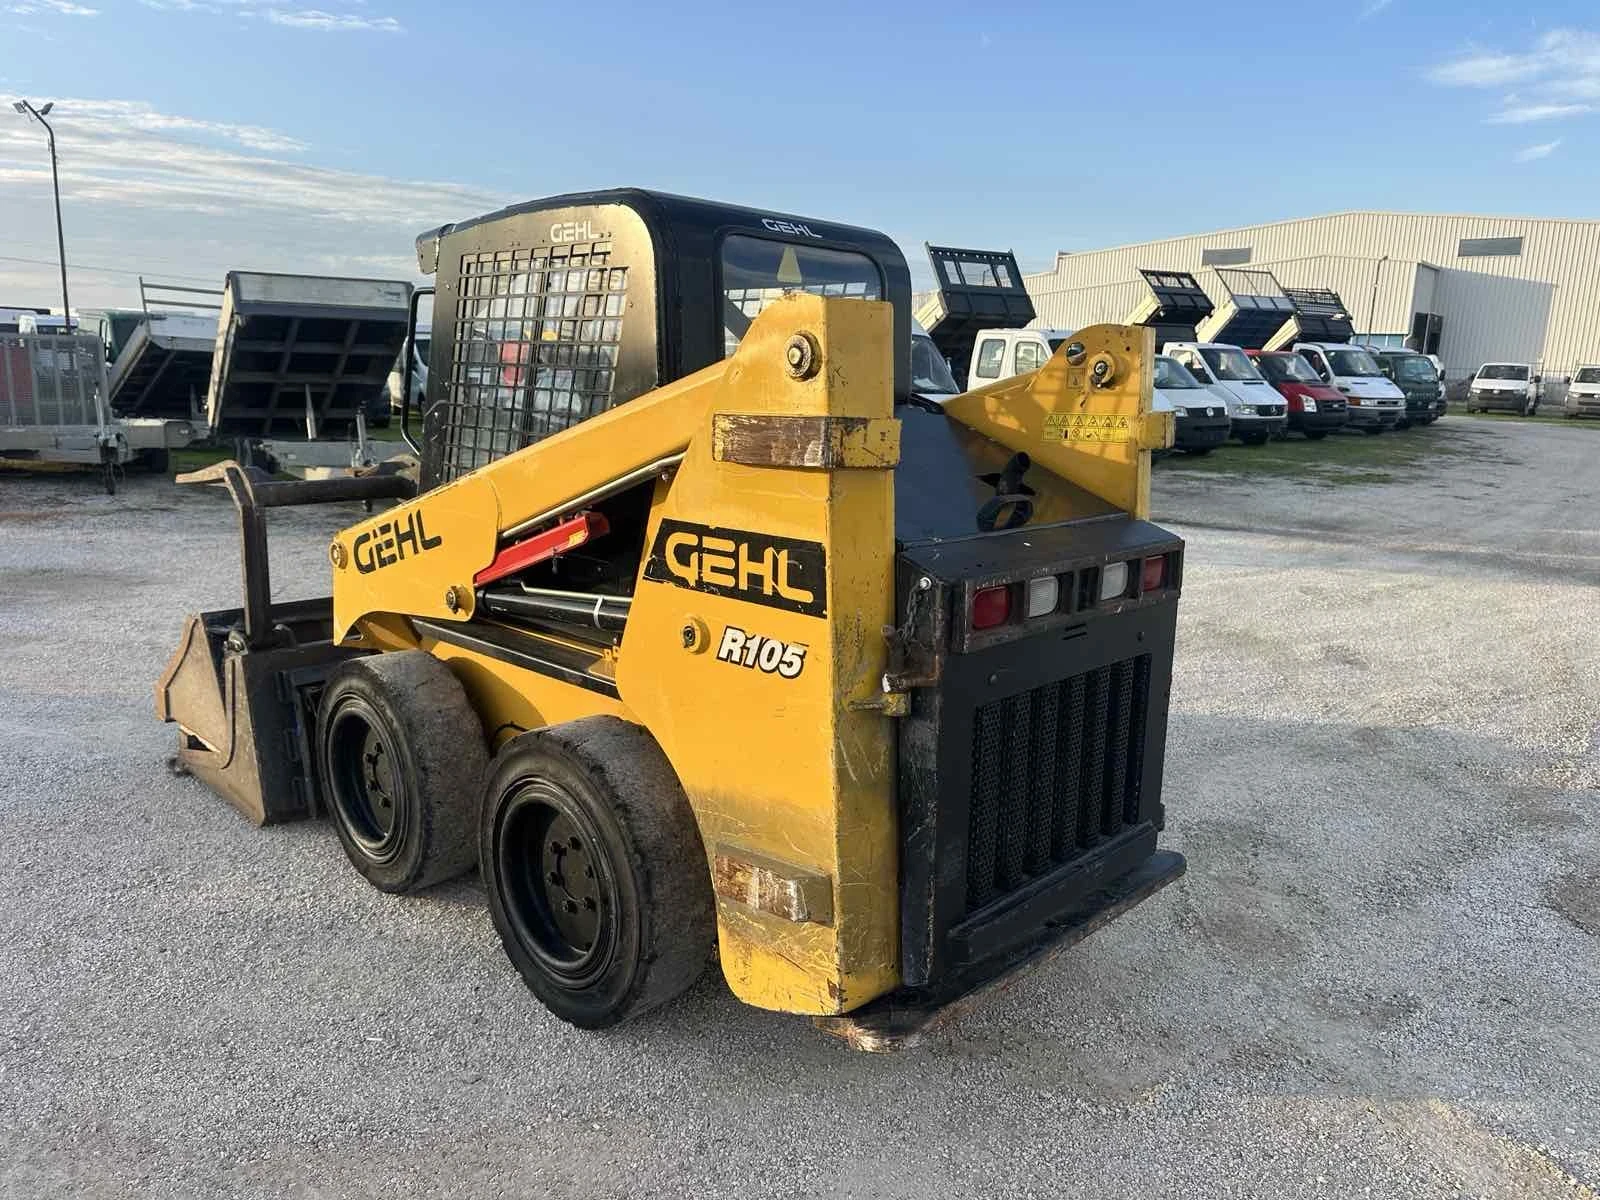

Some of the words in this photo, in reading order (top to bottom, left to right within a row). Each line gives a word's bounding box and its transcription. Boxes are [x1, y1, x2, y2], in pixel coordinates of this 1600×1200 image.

[550, 219, 602, 243] GEHL
[761, 217, 824, 239] GEHL
[353, 509, 443, 575] GEHL
[665, 530, 815, 604] GEHL
[716, 624, 809, 680] R105
